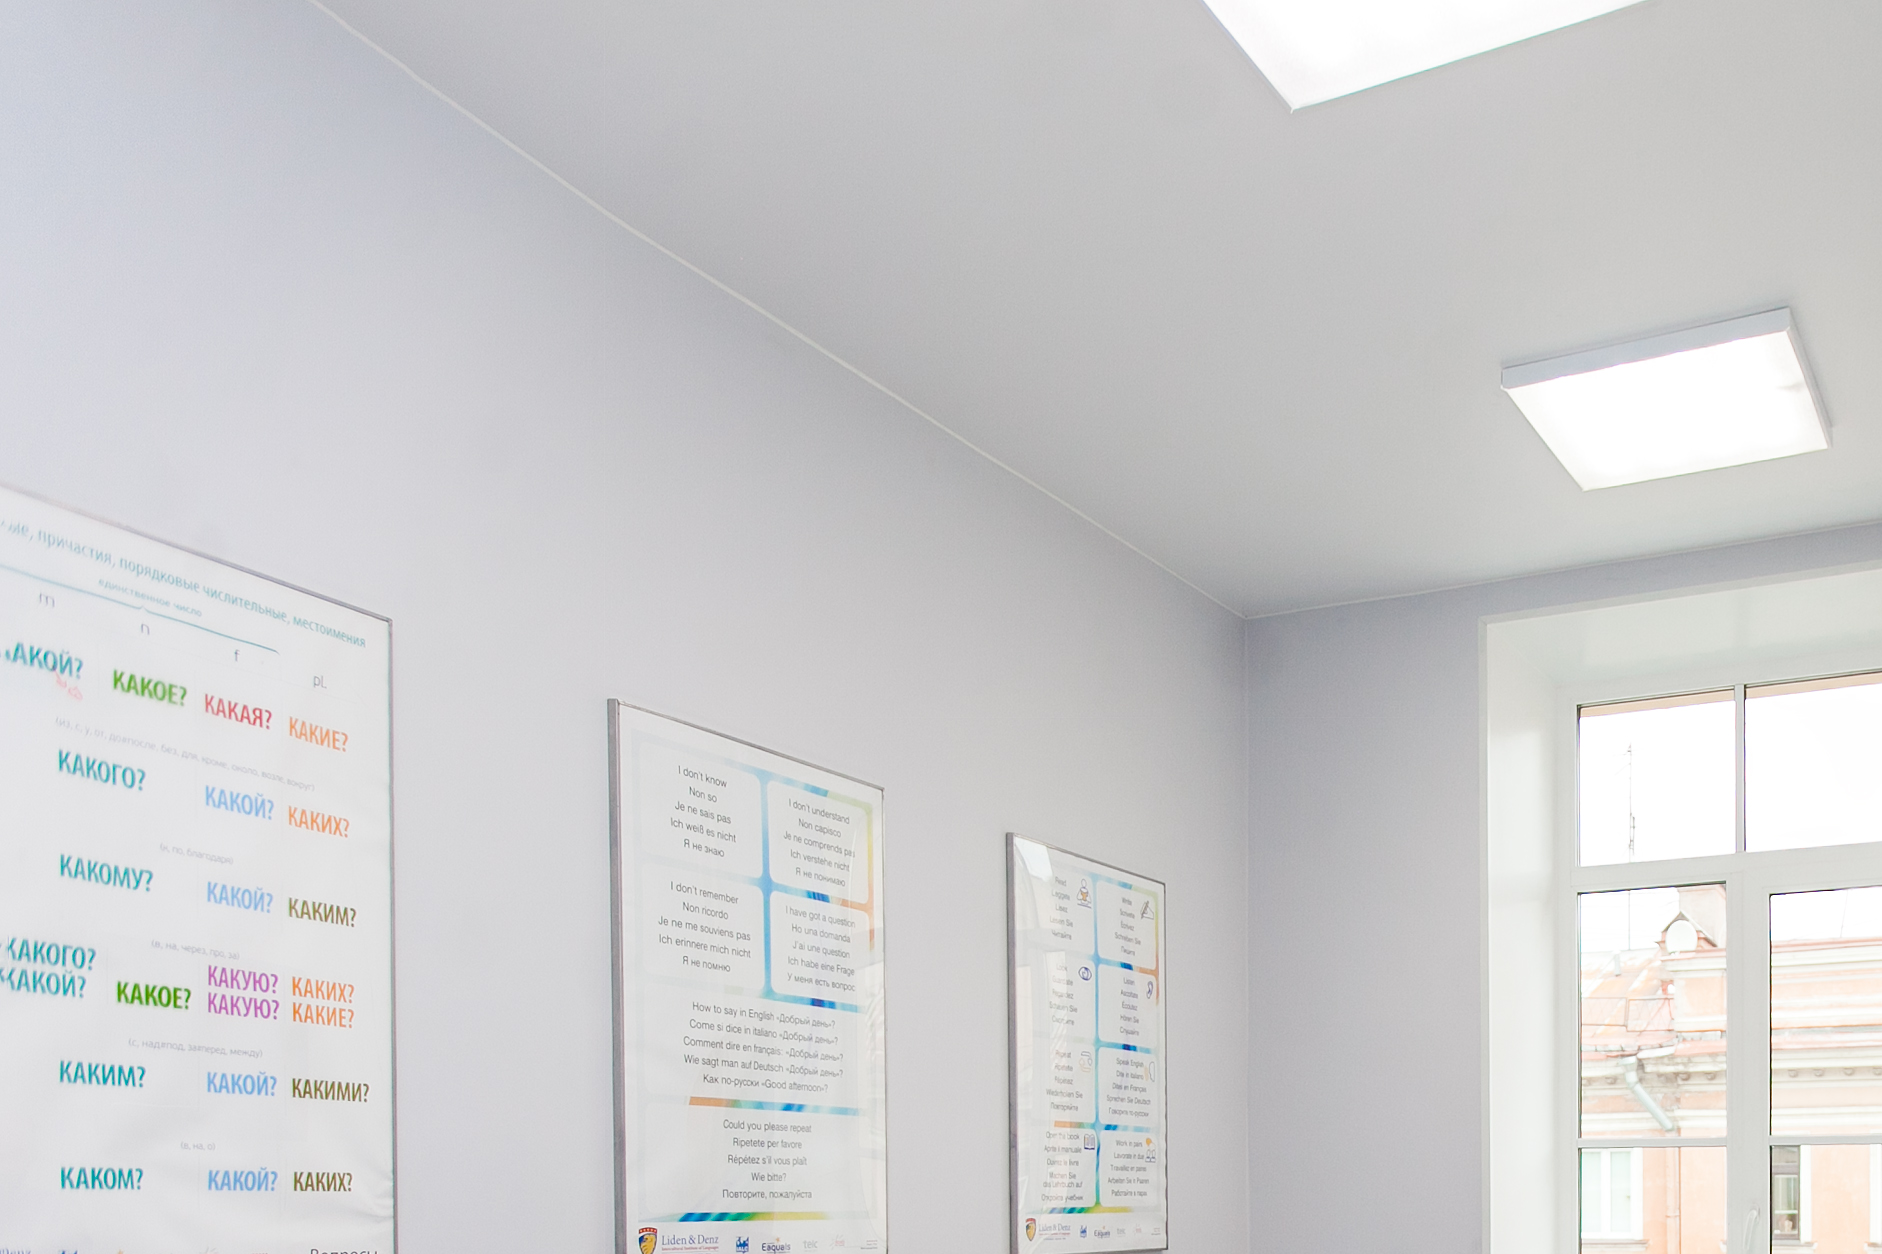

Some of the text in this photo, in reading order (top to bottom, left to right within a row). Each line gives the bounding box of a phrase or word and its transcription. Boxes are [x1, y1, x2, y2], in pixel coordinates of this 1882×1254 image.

[120, 556, 200, 593] порядковые
[293, 615, 366, 648] местоимения
[112, 668, 187, 707] КАКОЕ?
[205, 693, 272, 730] КАКАЯ?
[289, 716, 348, 752] КАКИЕ?
[705, 774, 727, 787] know
[58, 748, 350, 838] КАКОГО? КАКОЙ? КАКИХ?
[689, 786, 717, 802] Non so
[675, 801, 731, 824] Je ne sais pas
[812, 808, 849, 824] understand
[671, 817, 736, 842] Ich weiß es nicht
[799, 818, 841, 837] Non capisco
[684, 839, 689, 847] Я
[705, 846, 724, 857] знаю
[814, 872, 845, 886] понимаю
[60, 853, 357, 928] КАКОМУ? КАКОЙ? КАКИМ?
[700, 889, 739, 904] remember
[682, 902, 728, 919] Non ricordo
[659, 934, 751, 958] Ich erinnere mich nicht
[7, 936, 355, 1004] КАКОГО? КАКУЮ? КАКИХ?
[683, 956, 688, 965] Я
[703, 961, 730, 972] помню
[788, 956, 855, 977] Ich habe eine Frage
[794, 975, 813, 984] меня
[815, 979, 830, 987] есть
[832, 982, 855, 992] вопрос
[6, 967, 355, 1028] КАКОЙ? КАКОЕ? КАКУЮ? КАКИЕ?
[693, 1002, 711, 1012] How
[714, 1005, 721, 1013] to
[724, 1008, 737, 1018] say
[740, 1008, 746, 1017] in
[749, 1009, 774, 1021] English
[684, 1054, 699, 1064] Wie
[702, 1057, 719, 1068] sagt
[722, 1059, 738, 1067] man
[741, 1061, 751, 1069] auf
[754, 1061, 784, 1072] Deutsch
[60, 1060, 370, 1103] КАКИМ? КАКОЙ? КАКИМИ?
[703, 1074, 719, 1084] Как
[722, 1077, 759, 1088] по-русски
[723, 1119, 812, 1133] Could you please repeat
[733, 1137, 802, 1149] Ripetete per favore
[728, 1155, 760, 1165] Répétez
[61, 1166, 353, 1192] КАКОМ? КАКОЙ? КАКИХ?
[751, 1172, 786, 1181] Wie bitte?
[723, 1189, 812, 1200] Повторите, пожалуйста
[661, 1235, 719, 1245] Liden & Denz
[762, 1242, 790, 1254] Eaquals
[803, 1240, 817, 1249] telc
